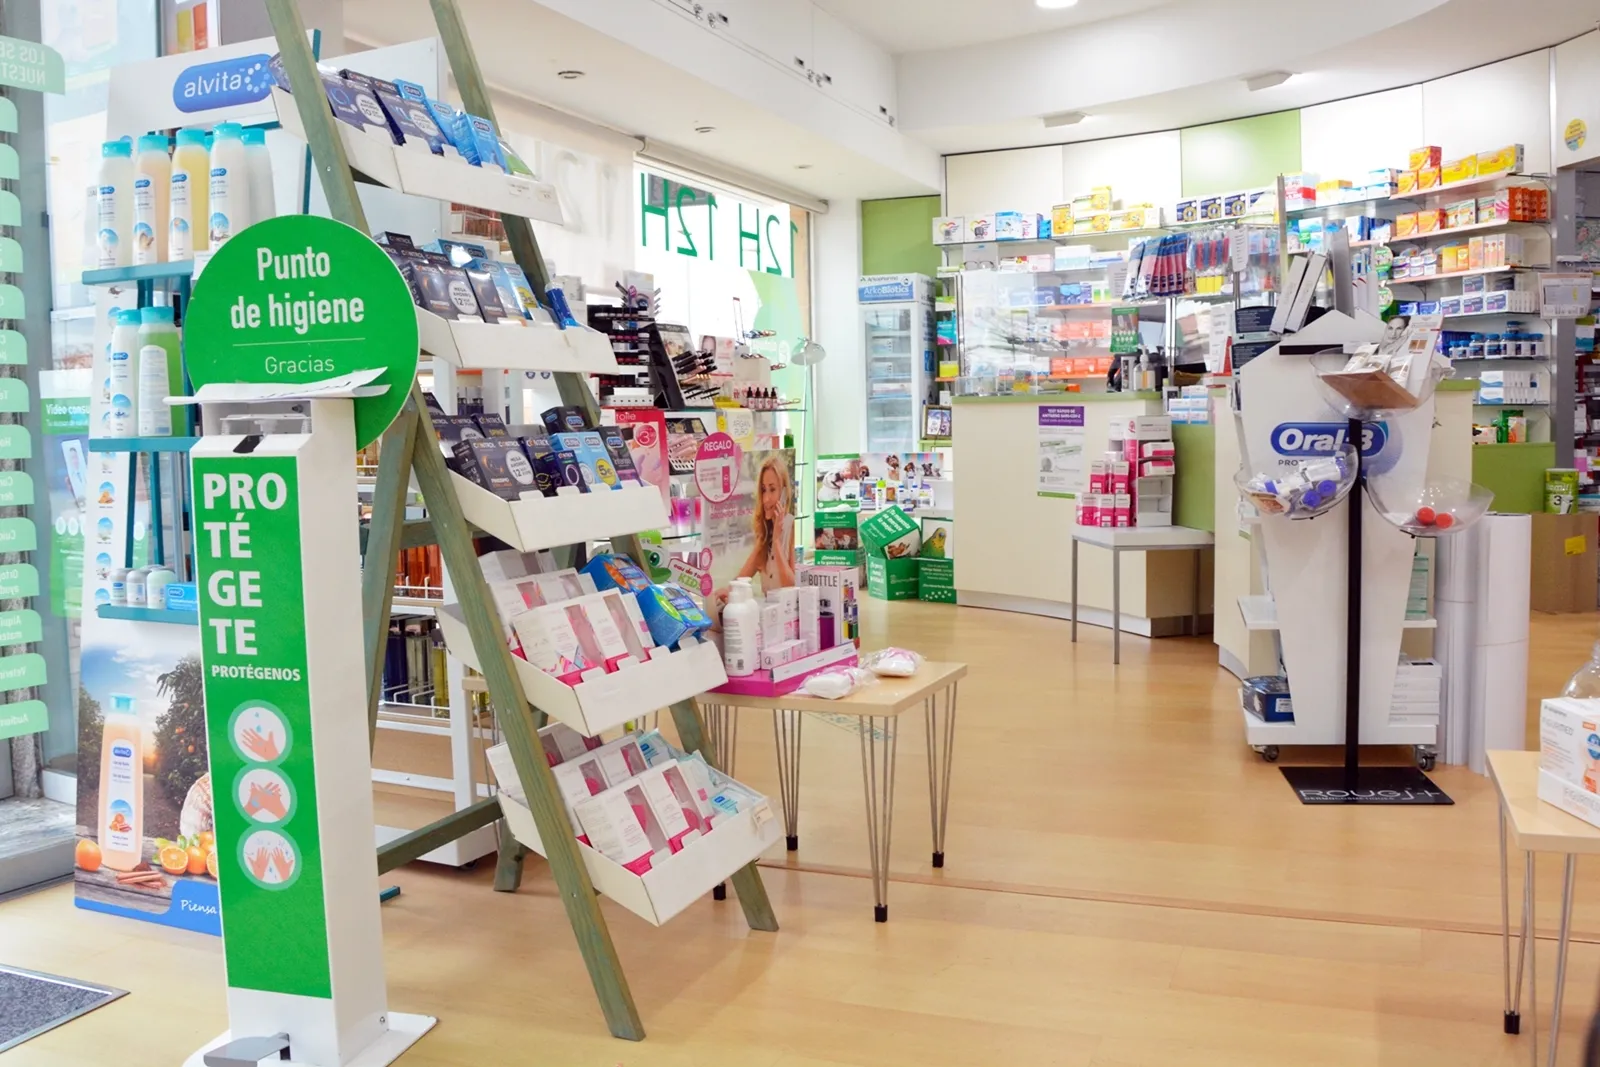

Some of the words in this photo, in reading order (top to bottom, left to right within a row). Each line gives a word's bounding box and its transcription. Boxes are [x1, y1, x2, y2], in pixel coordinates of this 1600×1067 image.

[184, 71, 241, 98] alvita
[257, 246, 331, 281] Punto
[863, 286, 909, 296] ArkoBiotics
[231, 299, 262, 330] de
[268, 293, 365, 335] higiene
[264, 355, 335, 375] Gracias
[704, 440, 732, 452] REGALO
[203, 472, 288, 511] PRO
[203, 512, 253, 559] TÉ
[207, 570, 263, 608] GE
[808, 574, 838, 588] BOTTLE
[209, 618, 258, 656] TE
[211, 663, 301, 682] PROTÉGENOS
[180, 898, 217, 916] Piensa
